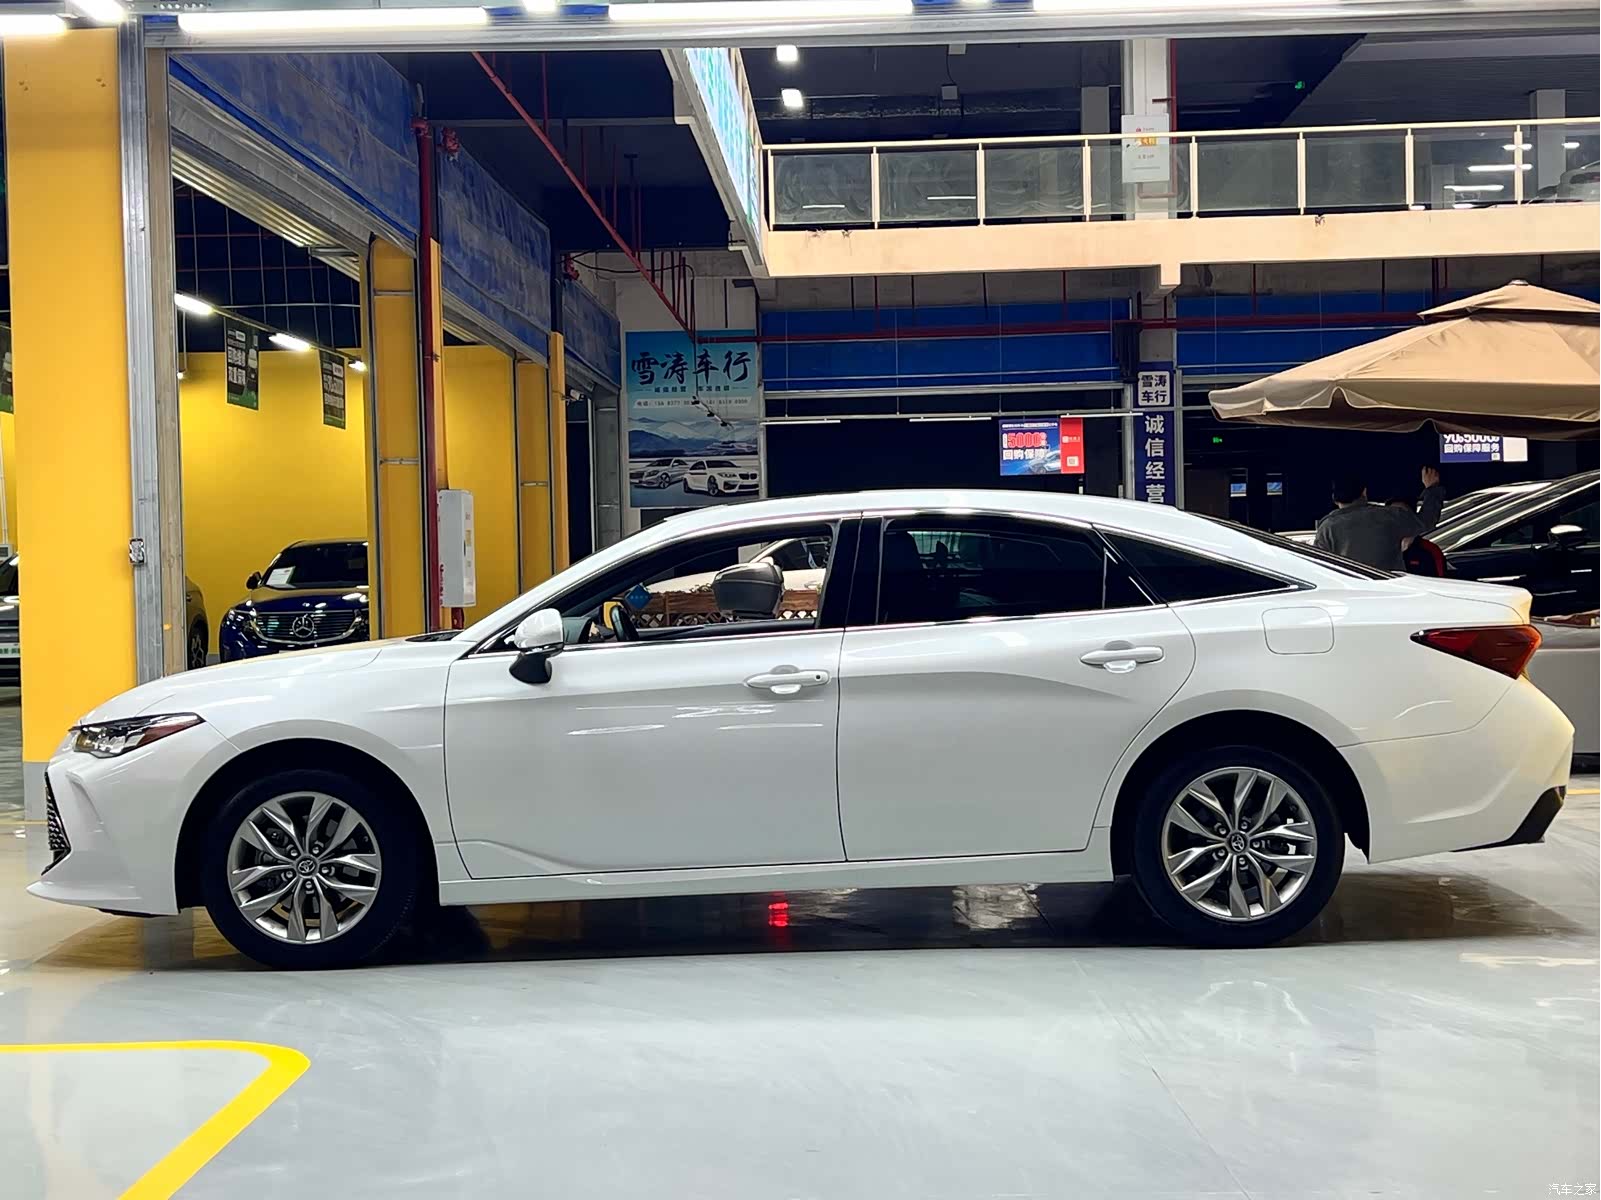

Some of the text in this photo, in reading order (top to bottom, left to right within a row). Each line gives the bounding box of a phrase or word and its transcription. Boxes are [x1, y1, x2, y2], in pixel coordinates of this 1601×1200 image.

[631, 348, 751, 385] 雪涛车行
[1141, 374, 1167, 388] 雪涛
[1141, 390, 1167, 404] 车行
[1144, 415, 1166, 503] 诚信经营
